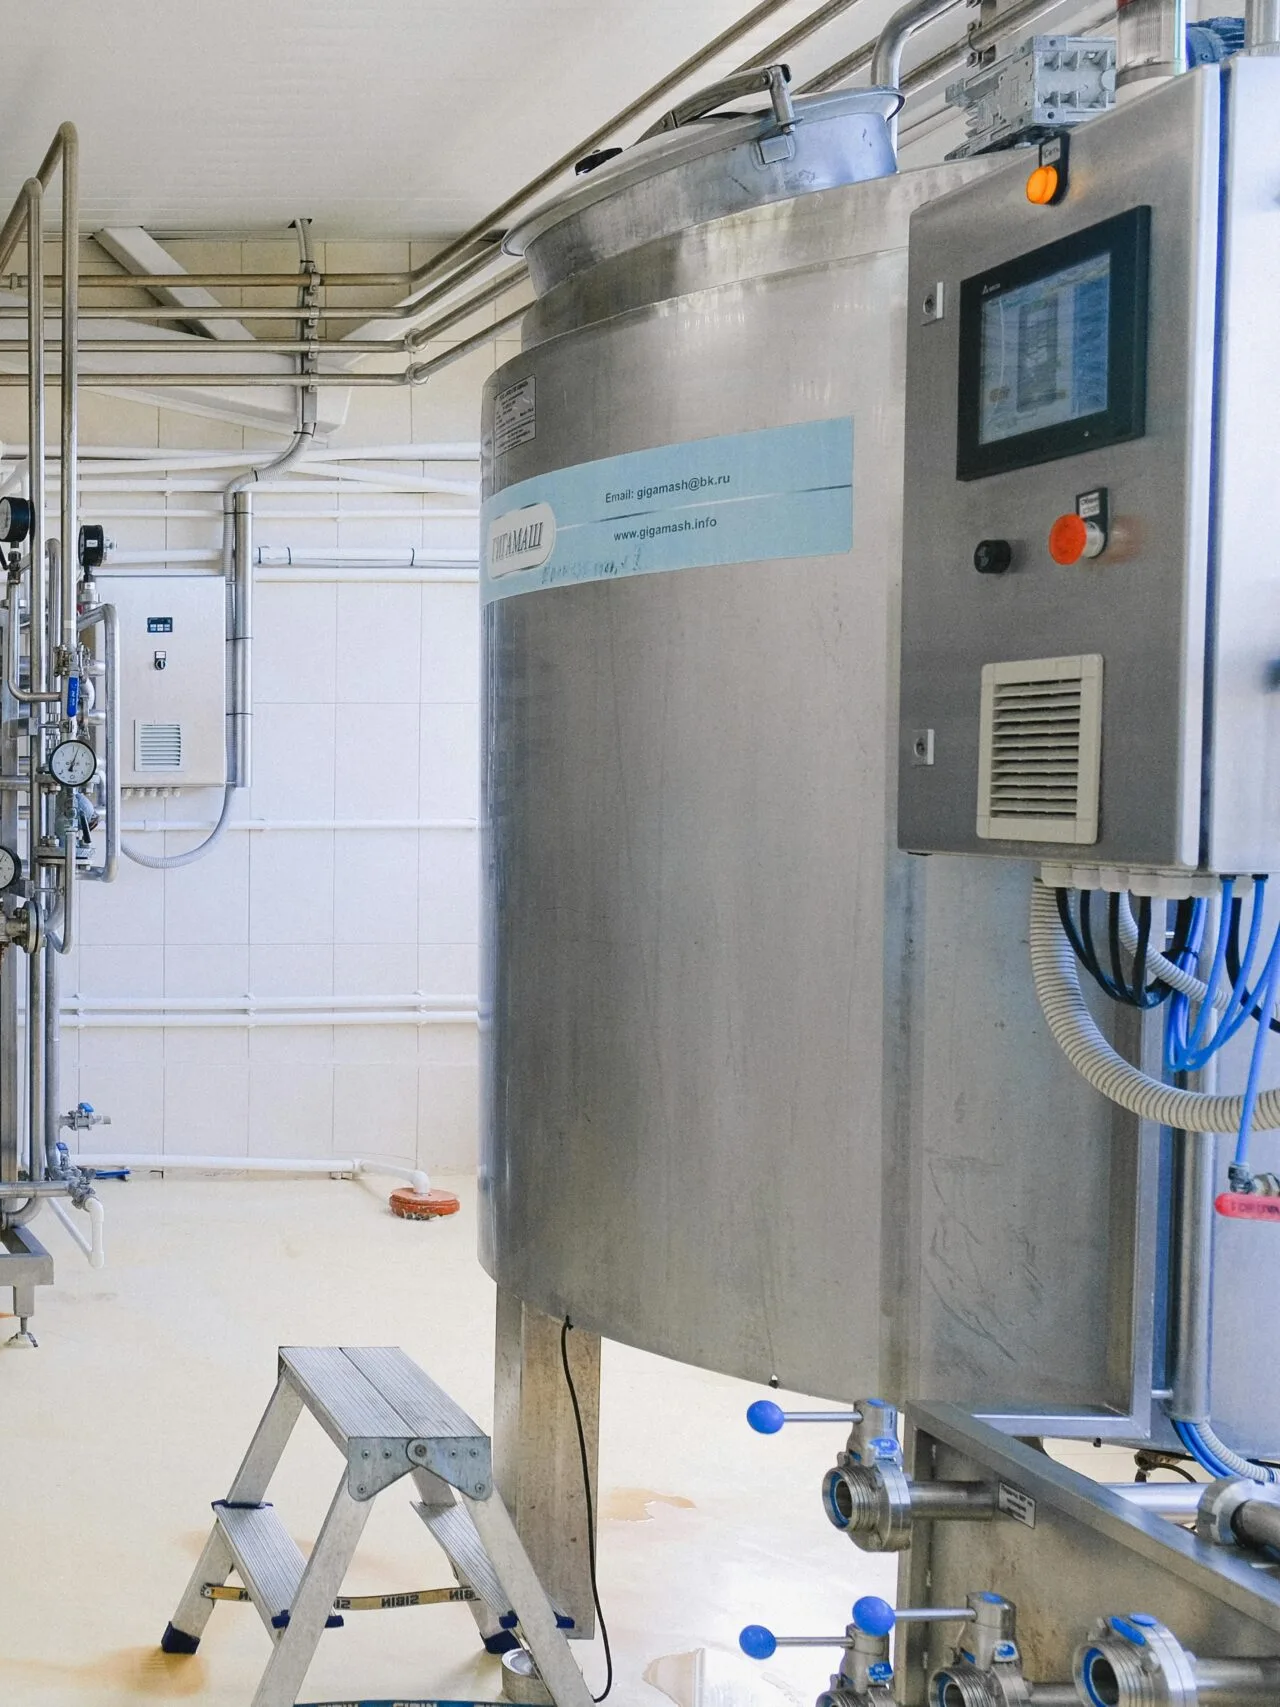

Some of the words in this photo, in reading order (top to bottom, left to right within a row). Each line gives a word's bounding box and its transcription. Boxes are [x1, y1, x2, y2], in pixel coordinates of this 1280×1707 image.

[605, 489, 634, 503] Email:
[637, 475, 730, 500] gigamash@bk.ru
[491, 521, 544, 564] ГИГАМАШ
[613, 517, 717, 541] www.gigamash.info
